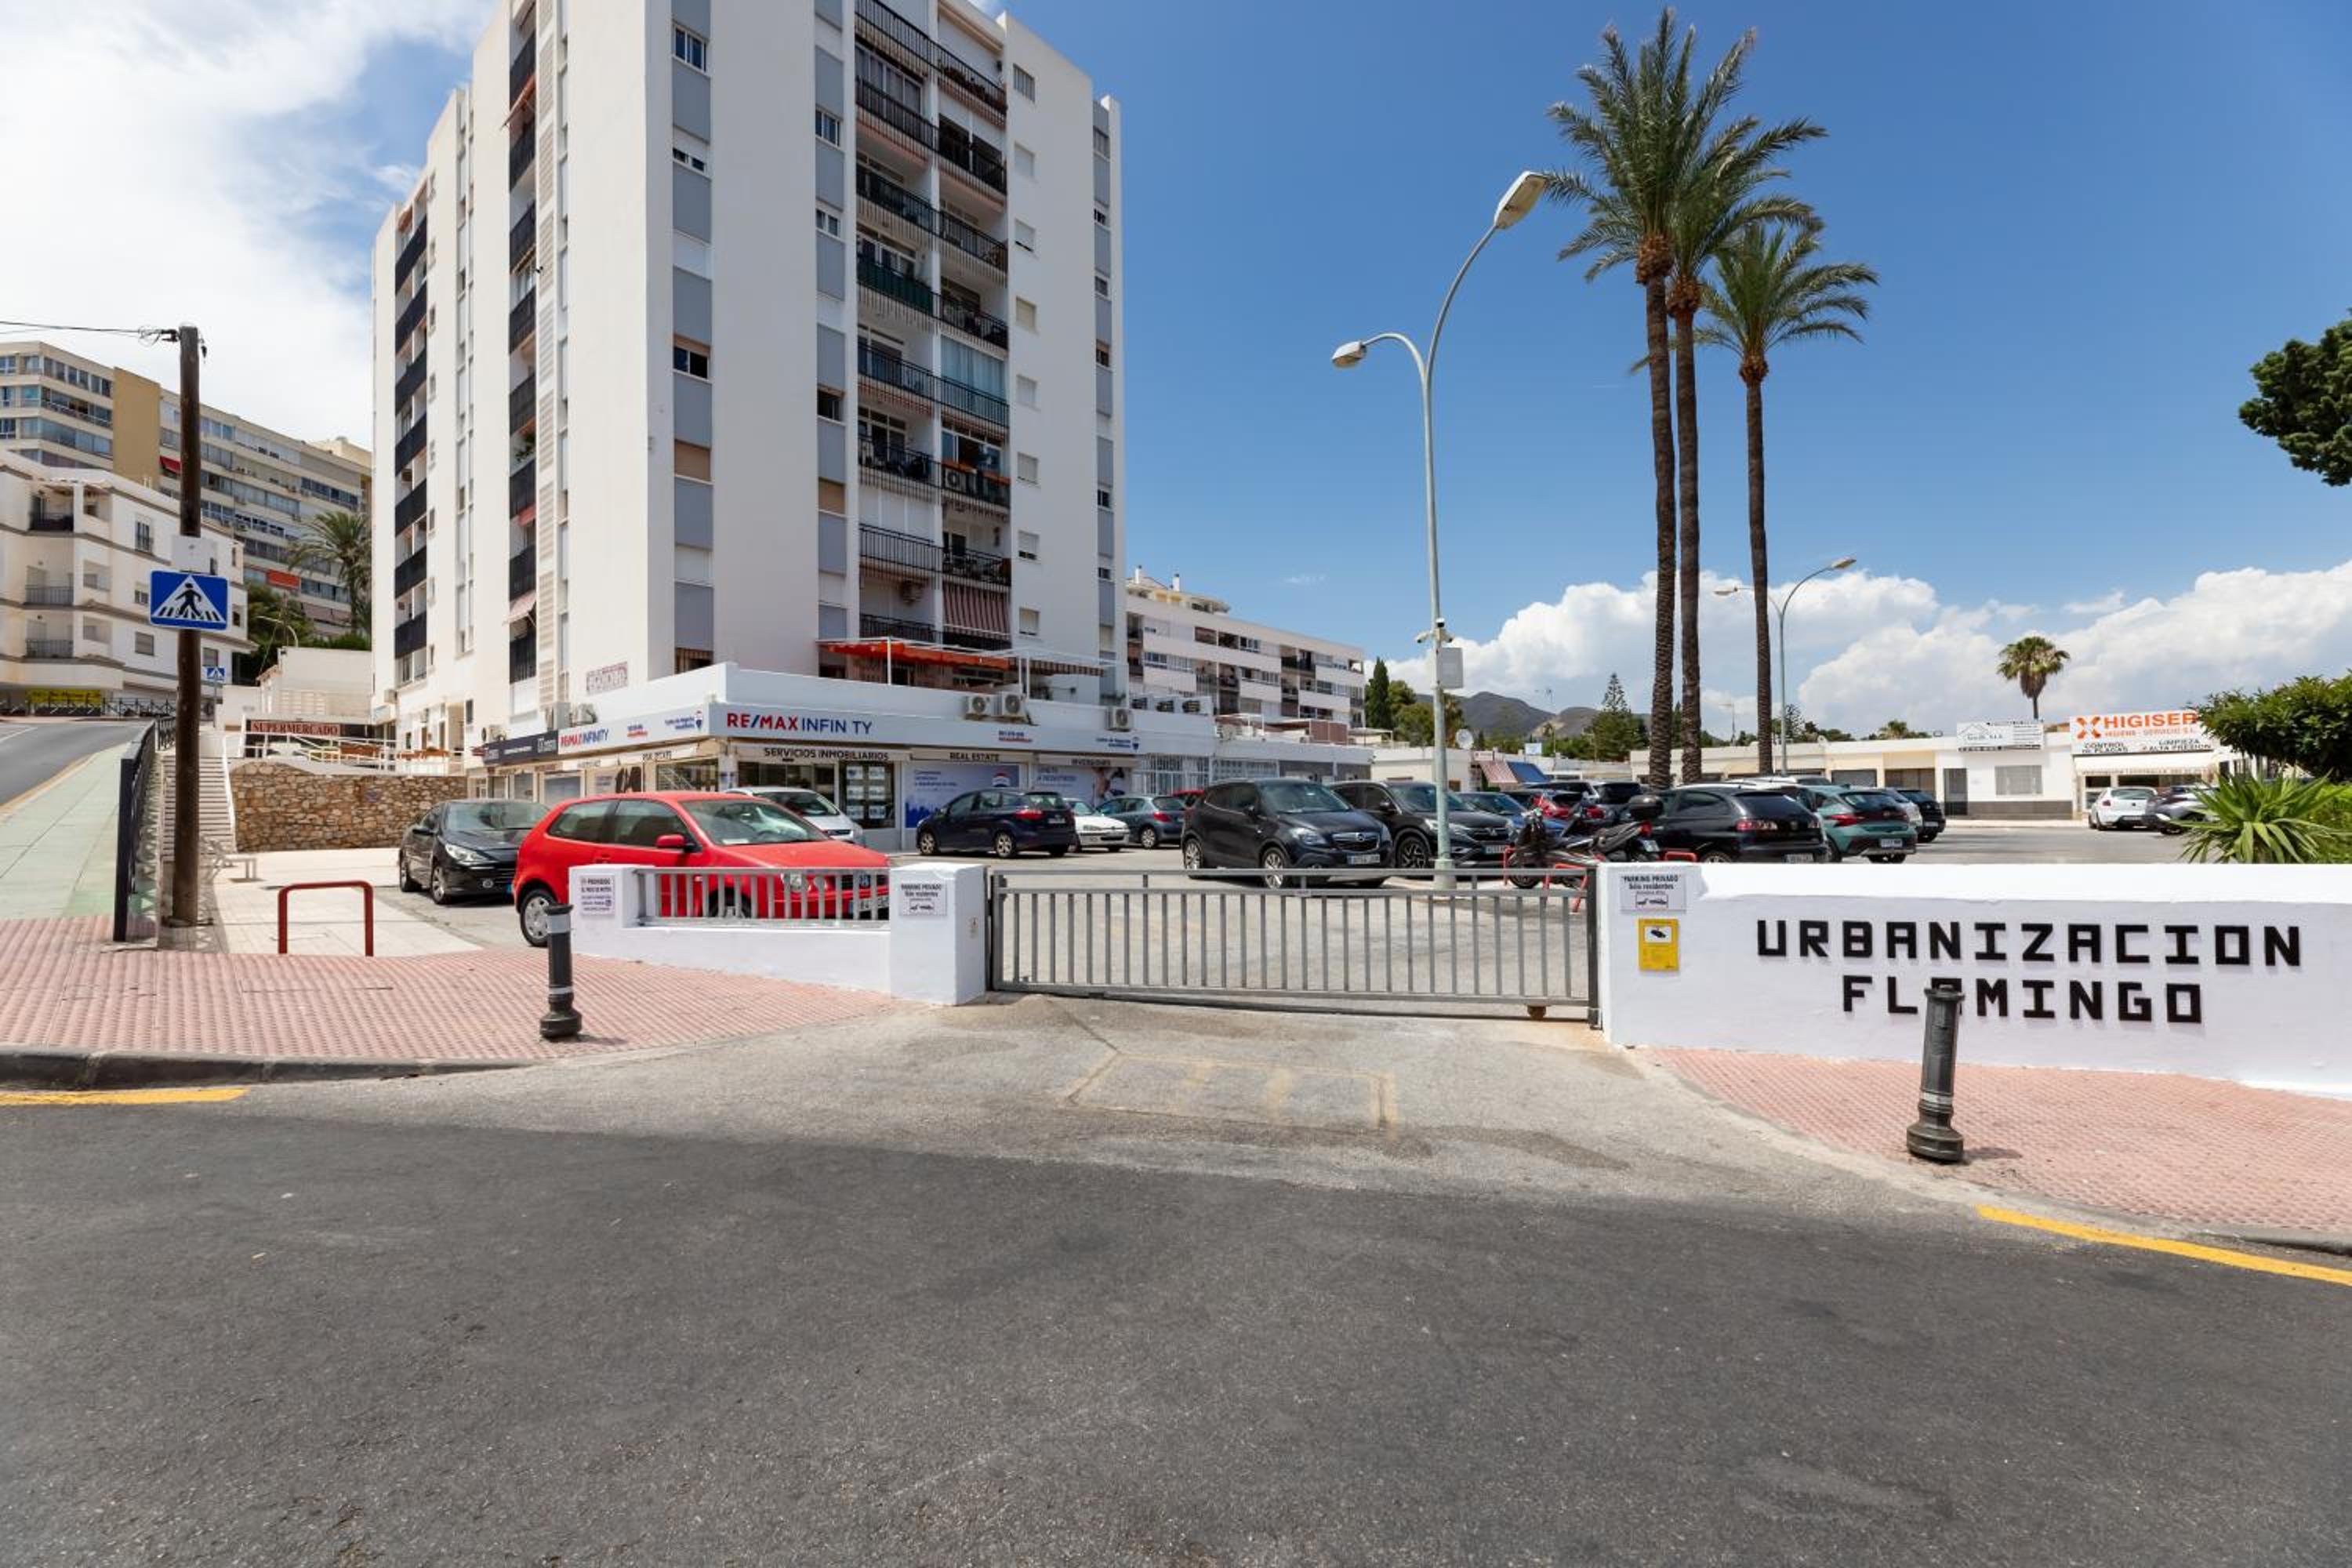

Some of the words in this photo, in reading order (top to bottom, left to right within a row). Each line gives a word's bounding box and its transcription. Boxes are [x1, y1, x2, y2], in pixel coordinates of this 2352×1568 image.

[252, 722, 339, 735] SUPERMERCADO
[727, 712, 798, 731] RE/MAX
[764, 747, 816, 758] SERVICIOS
[818, 749, 889, 761] INMOBILIARIOS
[971, 753, 1000, 761] ESTATE
[1756, 919, 2301, 967] URBANIZACION
